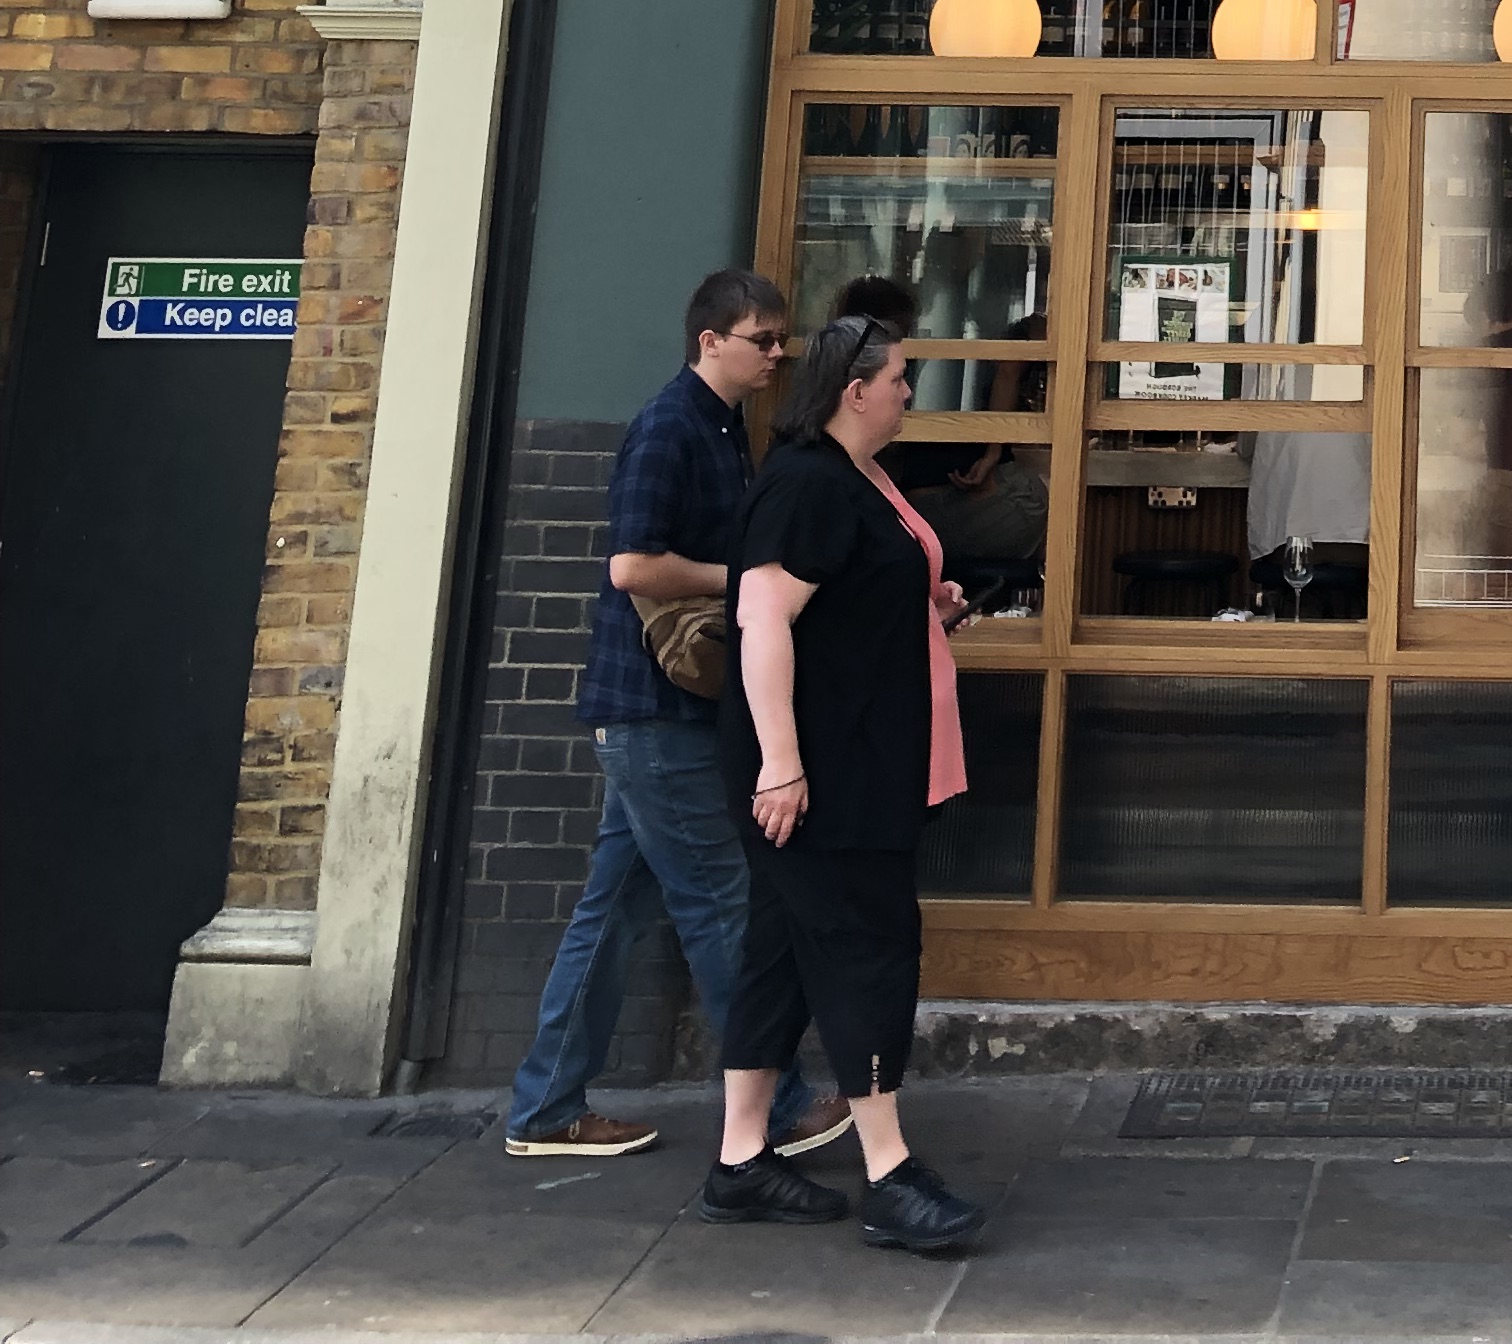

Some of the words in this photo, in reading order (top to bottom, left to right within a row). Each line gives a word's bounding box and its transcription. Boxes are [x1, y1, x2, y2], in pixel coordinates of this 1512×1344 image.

[181, 268, 234, 293] Fire
[241, 269, 292, 293] exit
[164, 302, 233, 332] Keep
[239, 303, 299, 328] clea
